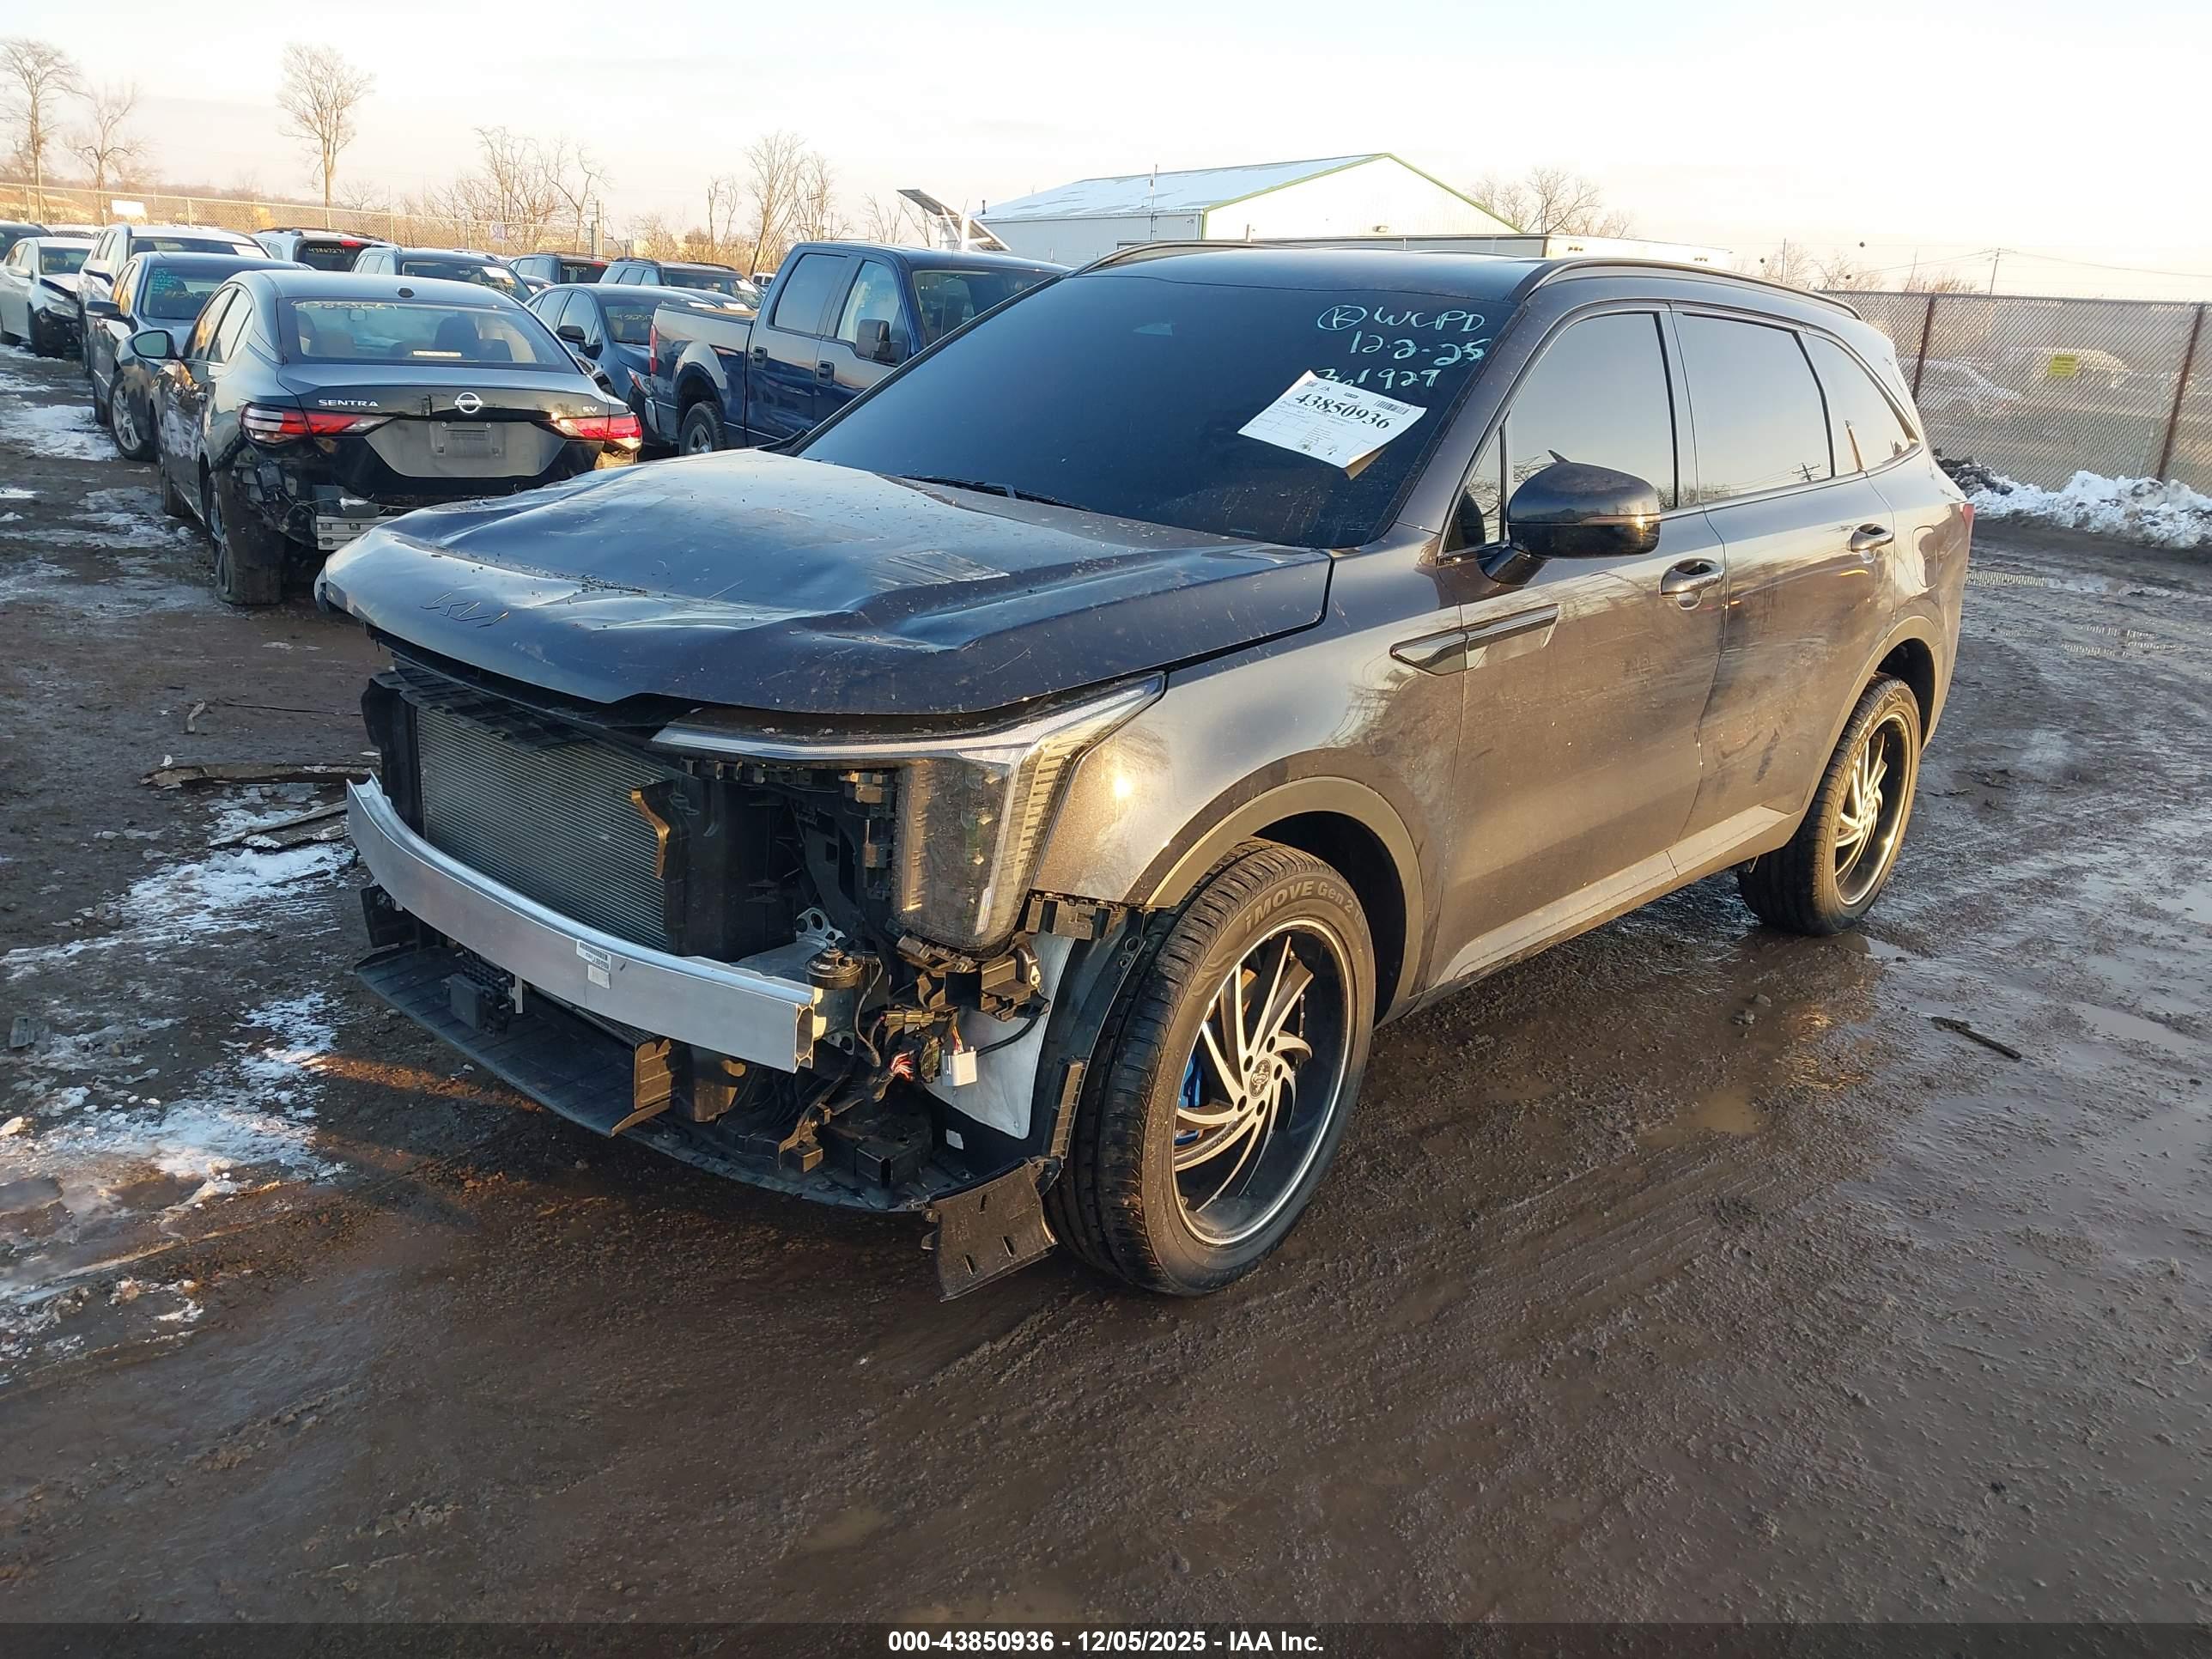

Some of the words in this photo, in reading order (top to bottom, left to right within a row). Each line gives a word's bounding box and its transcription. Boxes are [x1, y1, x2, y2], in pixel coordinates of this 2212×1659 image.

[1374, 307, 1486, 331] WCPD
[1294, 393, 1396, 430] 43850936
[1318, 881, 1345, 905] Gen
[1343, 899, 1354, 913] 2
